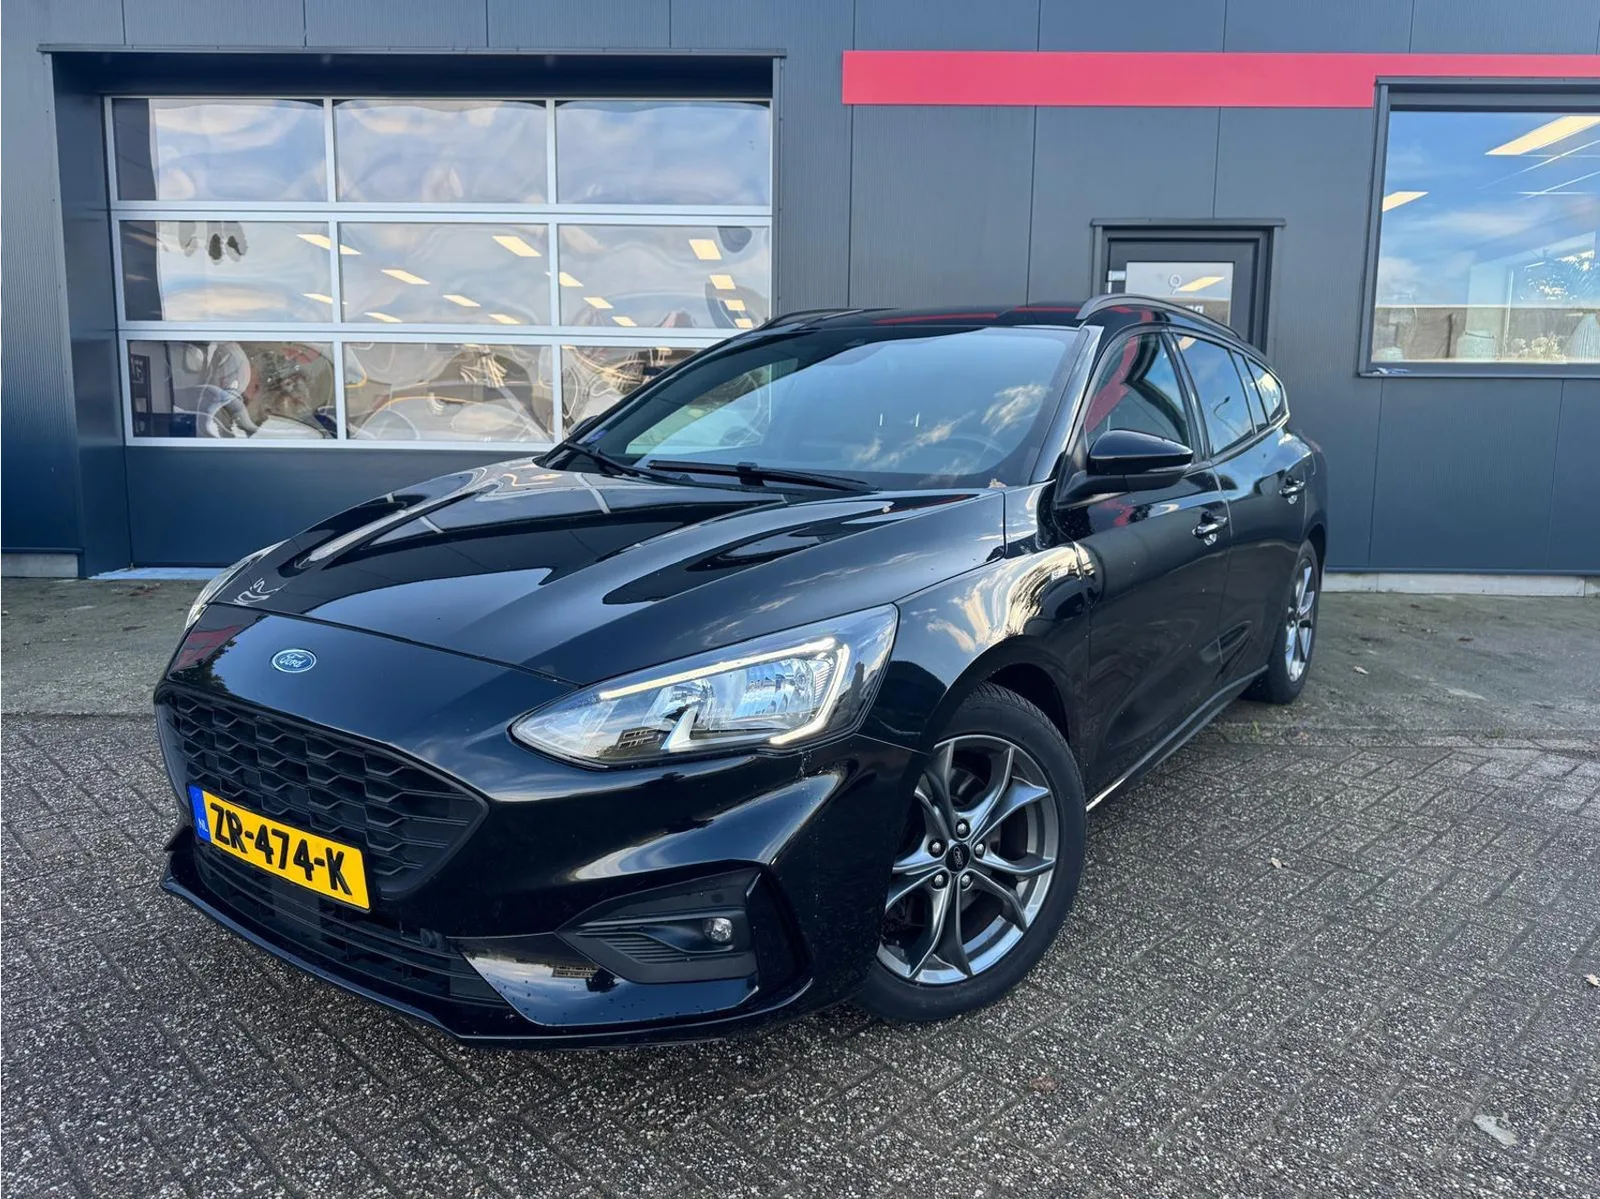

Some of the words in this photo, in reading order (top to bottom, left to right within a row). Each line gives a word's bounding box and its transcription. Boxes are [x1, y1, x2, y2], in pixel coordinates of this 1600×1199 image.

[279, 652, 308, 668] Ford
[198, 817, 209, 833] NL
[210, 802, 353, 896] ZR-474-K
